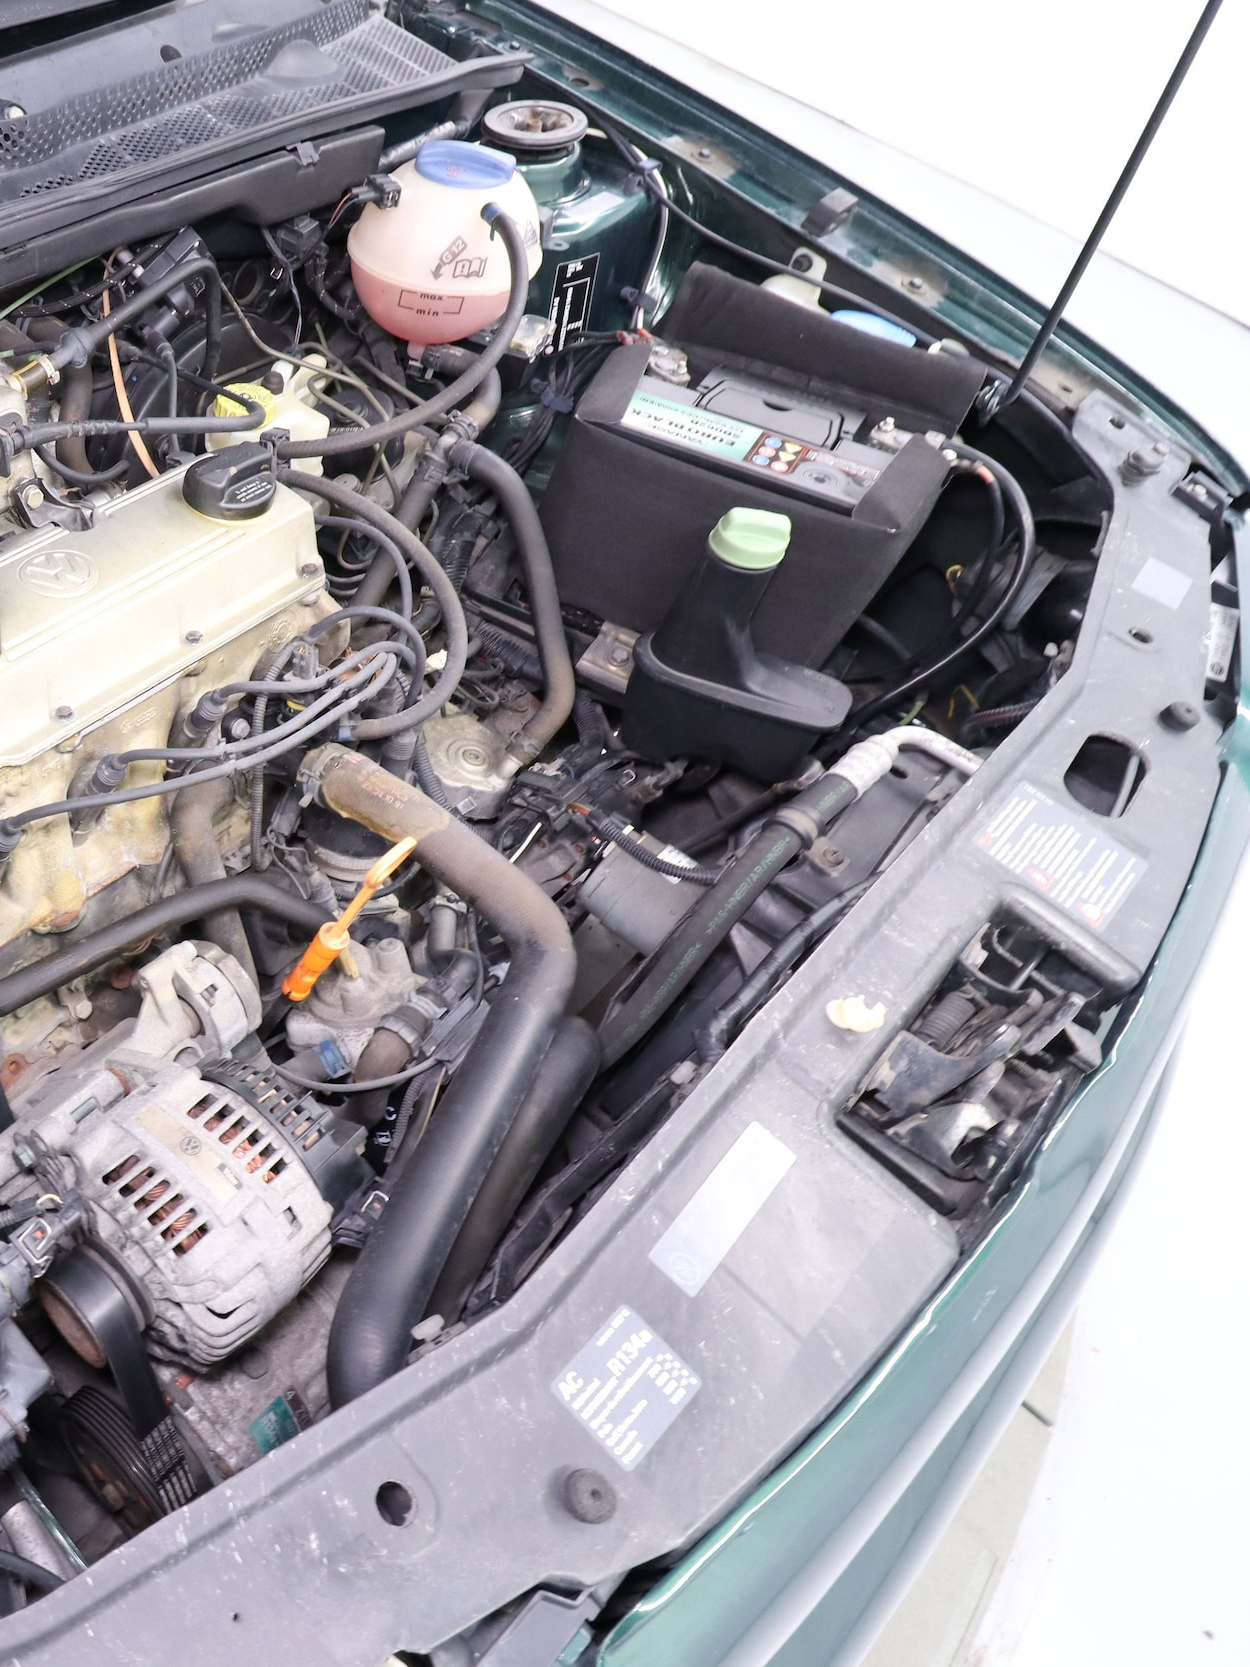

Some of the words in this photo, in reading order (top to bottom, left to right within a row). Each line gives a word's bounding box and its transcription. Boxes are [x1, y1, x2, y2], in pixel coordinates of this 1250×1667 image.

[442, 251, 453, 264] G
[452, 240, 465, 254] 12
[419, 292, 444, 301] max
[416, 308, 439, 317] min
[630, 408, 686, 430] BLACK
[686, 426, 736, 447] EURO
[606, 1329, 653, 1377] R134a
[558, 1371, 584, 1401] AC
